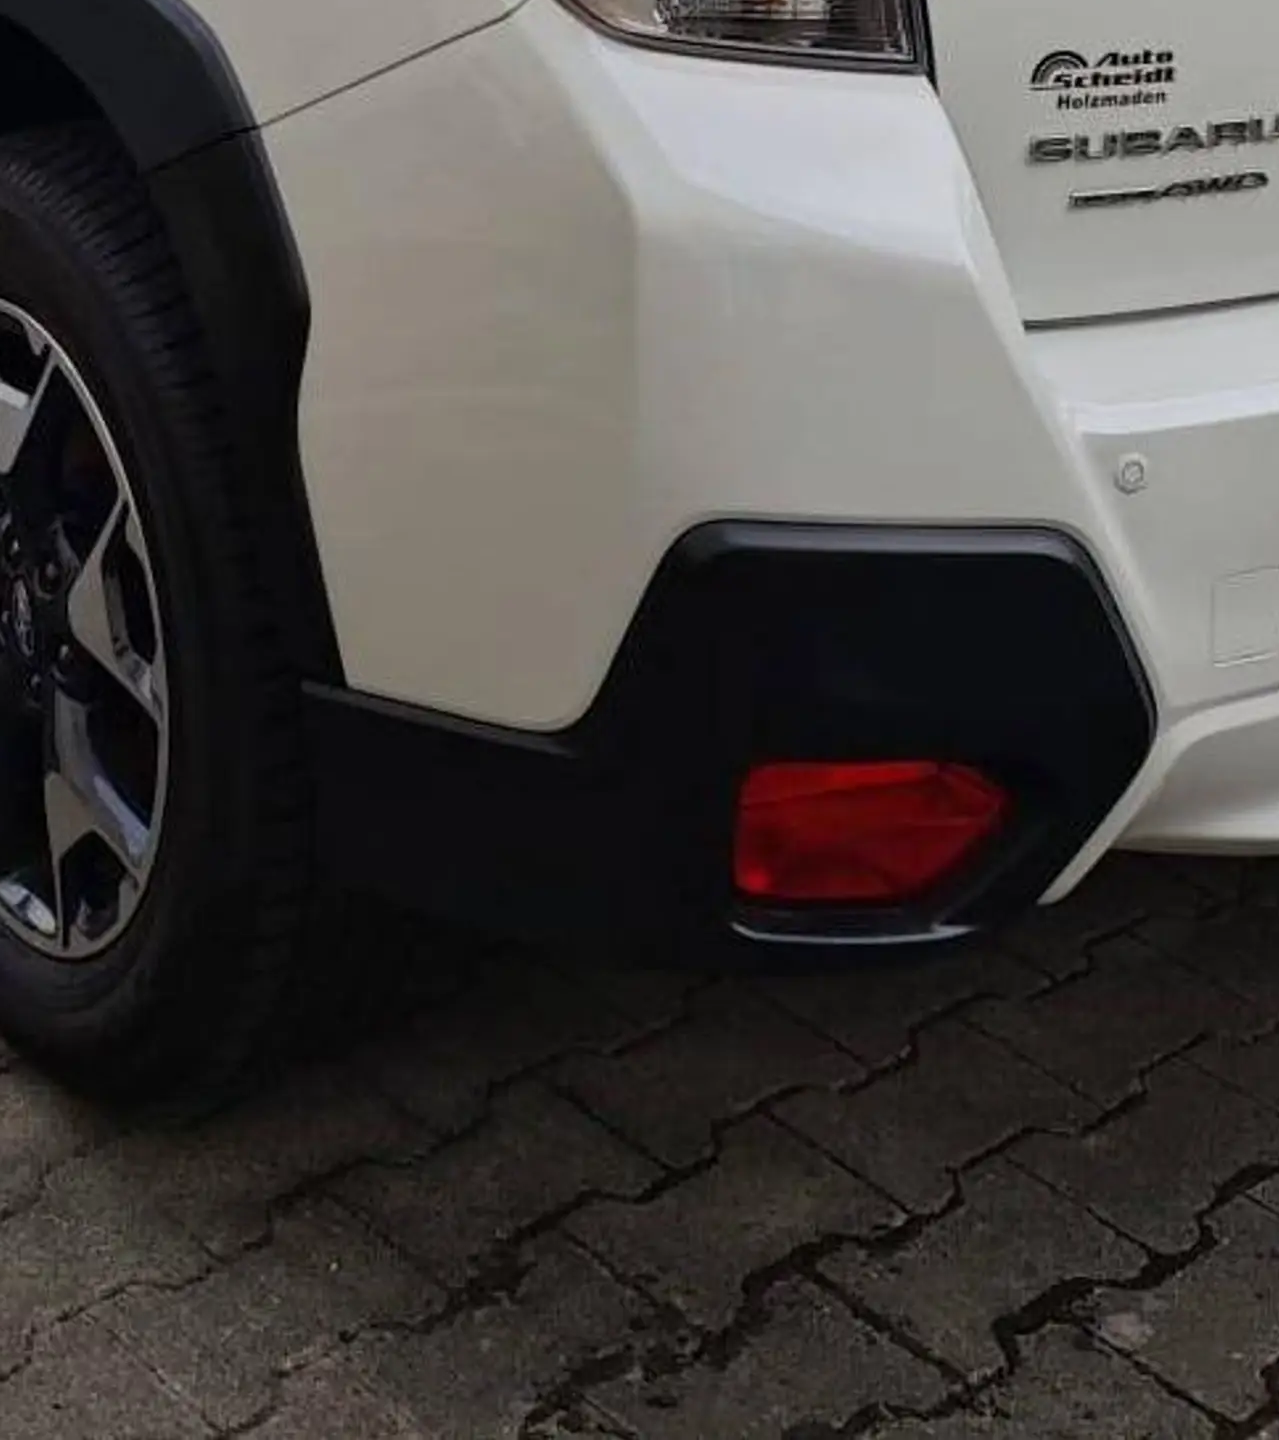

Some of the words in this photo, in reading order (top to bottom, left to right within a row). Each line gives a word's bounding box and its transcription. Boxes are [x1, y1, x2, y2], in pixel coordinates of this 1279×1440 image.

[1095, 49, 1174, 67] Auto
[1053, 66, 1176, 89] Scheidt
[1057, 90, 1166, 110] Holzmaden
